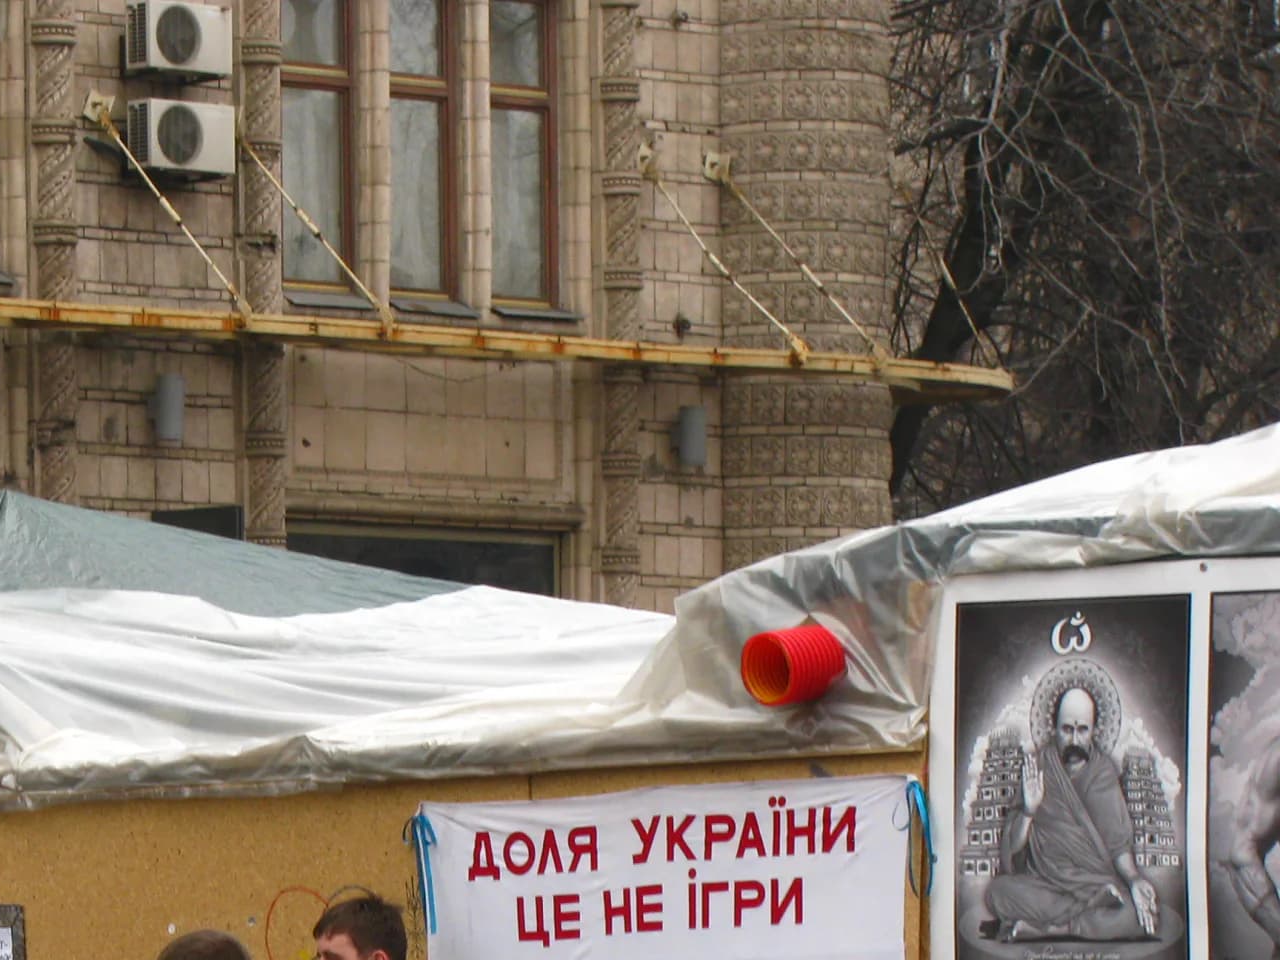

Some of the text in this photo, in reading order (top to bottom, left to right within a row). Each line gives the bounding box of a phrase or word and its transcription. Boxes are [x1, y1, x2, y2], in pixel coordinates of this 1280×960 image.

[468, 796, 857, 881] ДОЛЯ УКРАЇНИ
[517, 893, 581, 947] ЦЕ
[604, 884, 664, 935] НЕ
